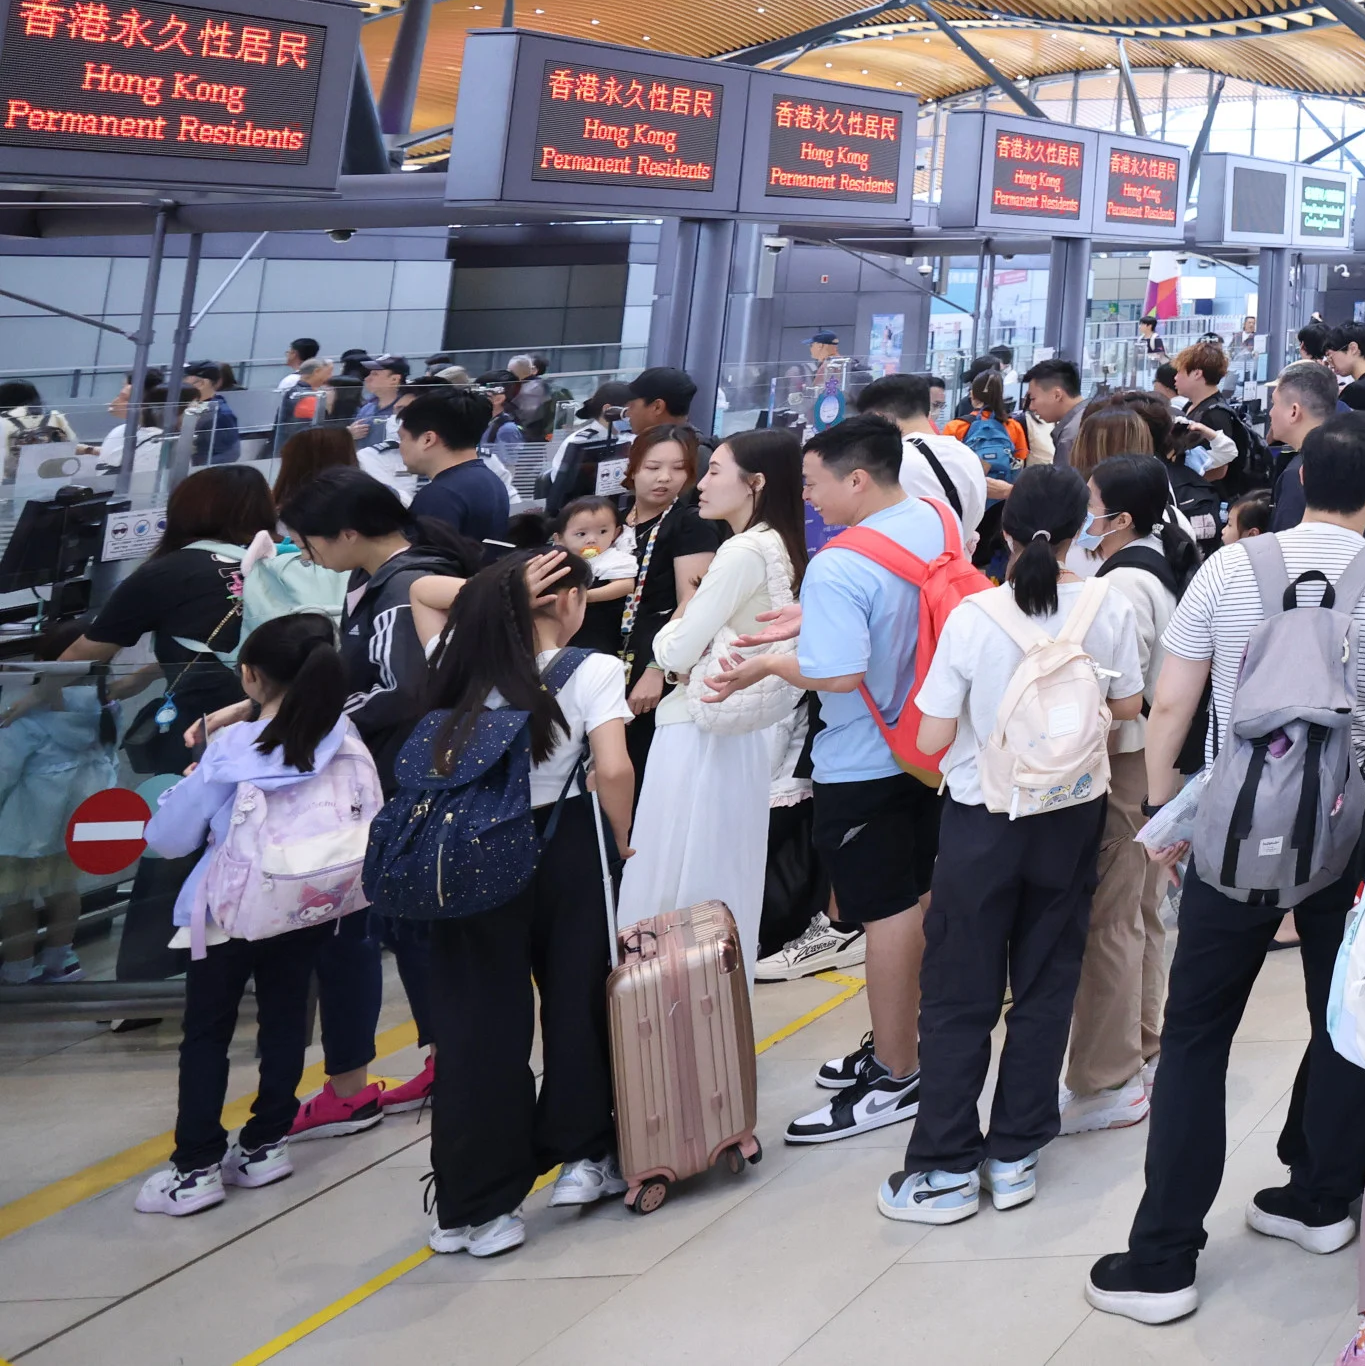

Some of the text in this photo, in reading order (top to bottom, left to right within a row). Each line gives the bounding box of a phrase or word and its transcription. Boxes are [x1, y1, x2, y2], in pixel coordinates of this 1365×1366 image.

[81, 62, 247, 114] Hong Kong
[549, 69, 714, 118] 香港永久性居民
[4, 99, 304, 150] Permanent Residents
[583, 117, 678, 153] Hong Kong
[776, 101, 897, 141] 香港永久性居民
[540, 146, 712, 180] Permanent Residents
[800, 142, 870, 171] Hong Kong
[997, 136, 1079, 167] 香港永久性居民
[770, 167, 895, 194] Permanent Residents
[1014, 169, 1061, 193] Hong Kong
[1111, 153, 1176, 182] 香港永久性居民
[994, 190, 1078, 211] Permanent Residents
[1123, 183, 1161, 204] Hong Kong
[1107, 201, 1175, 221] Permanent Residents
